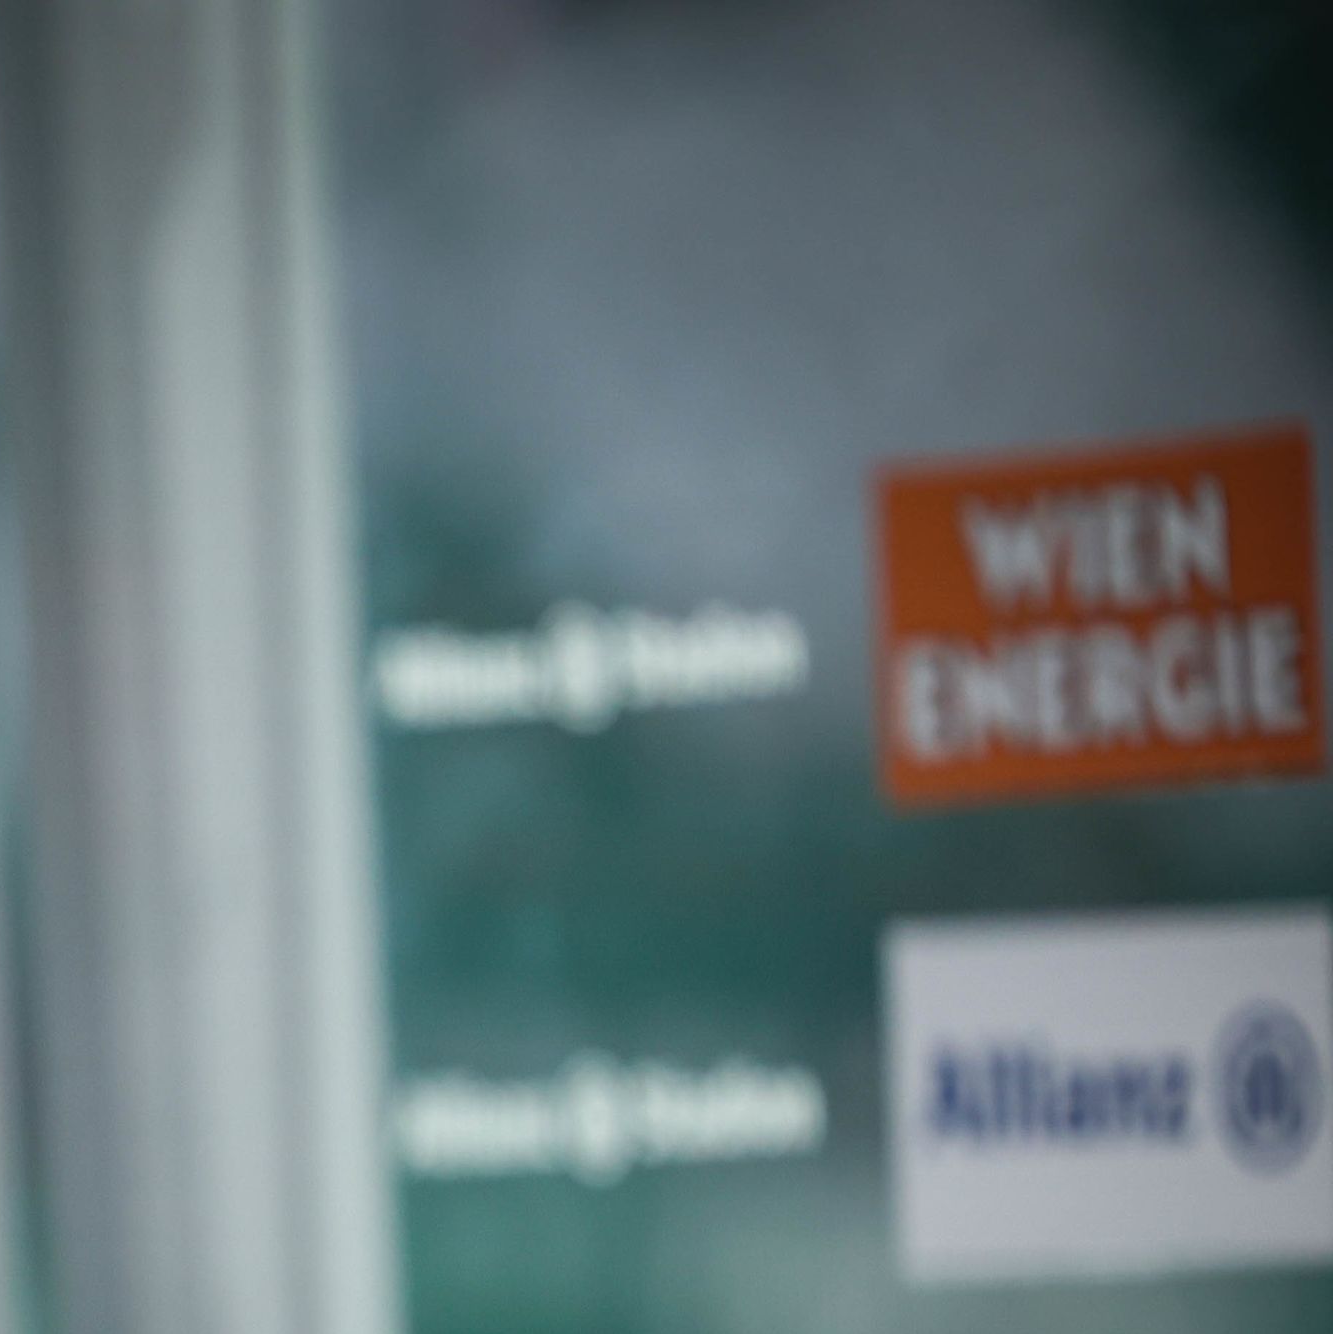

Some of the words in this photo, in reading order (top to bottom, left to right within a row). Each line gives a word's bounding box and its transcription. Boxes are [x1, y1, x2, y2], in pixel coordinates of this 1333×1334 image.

[959, 474, 1231, 612] WIEN
[897, 604, 1309, 766] ENERGIE
[925, 1028, 1195, 1152] Allianz
